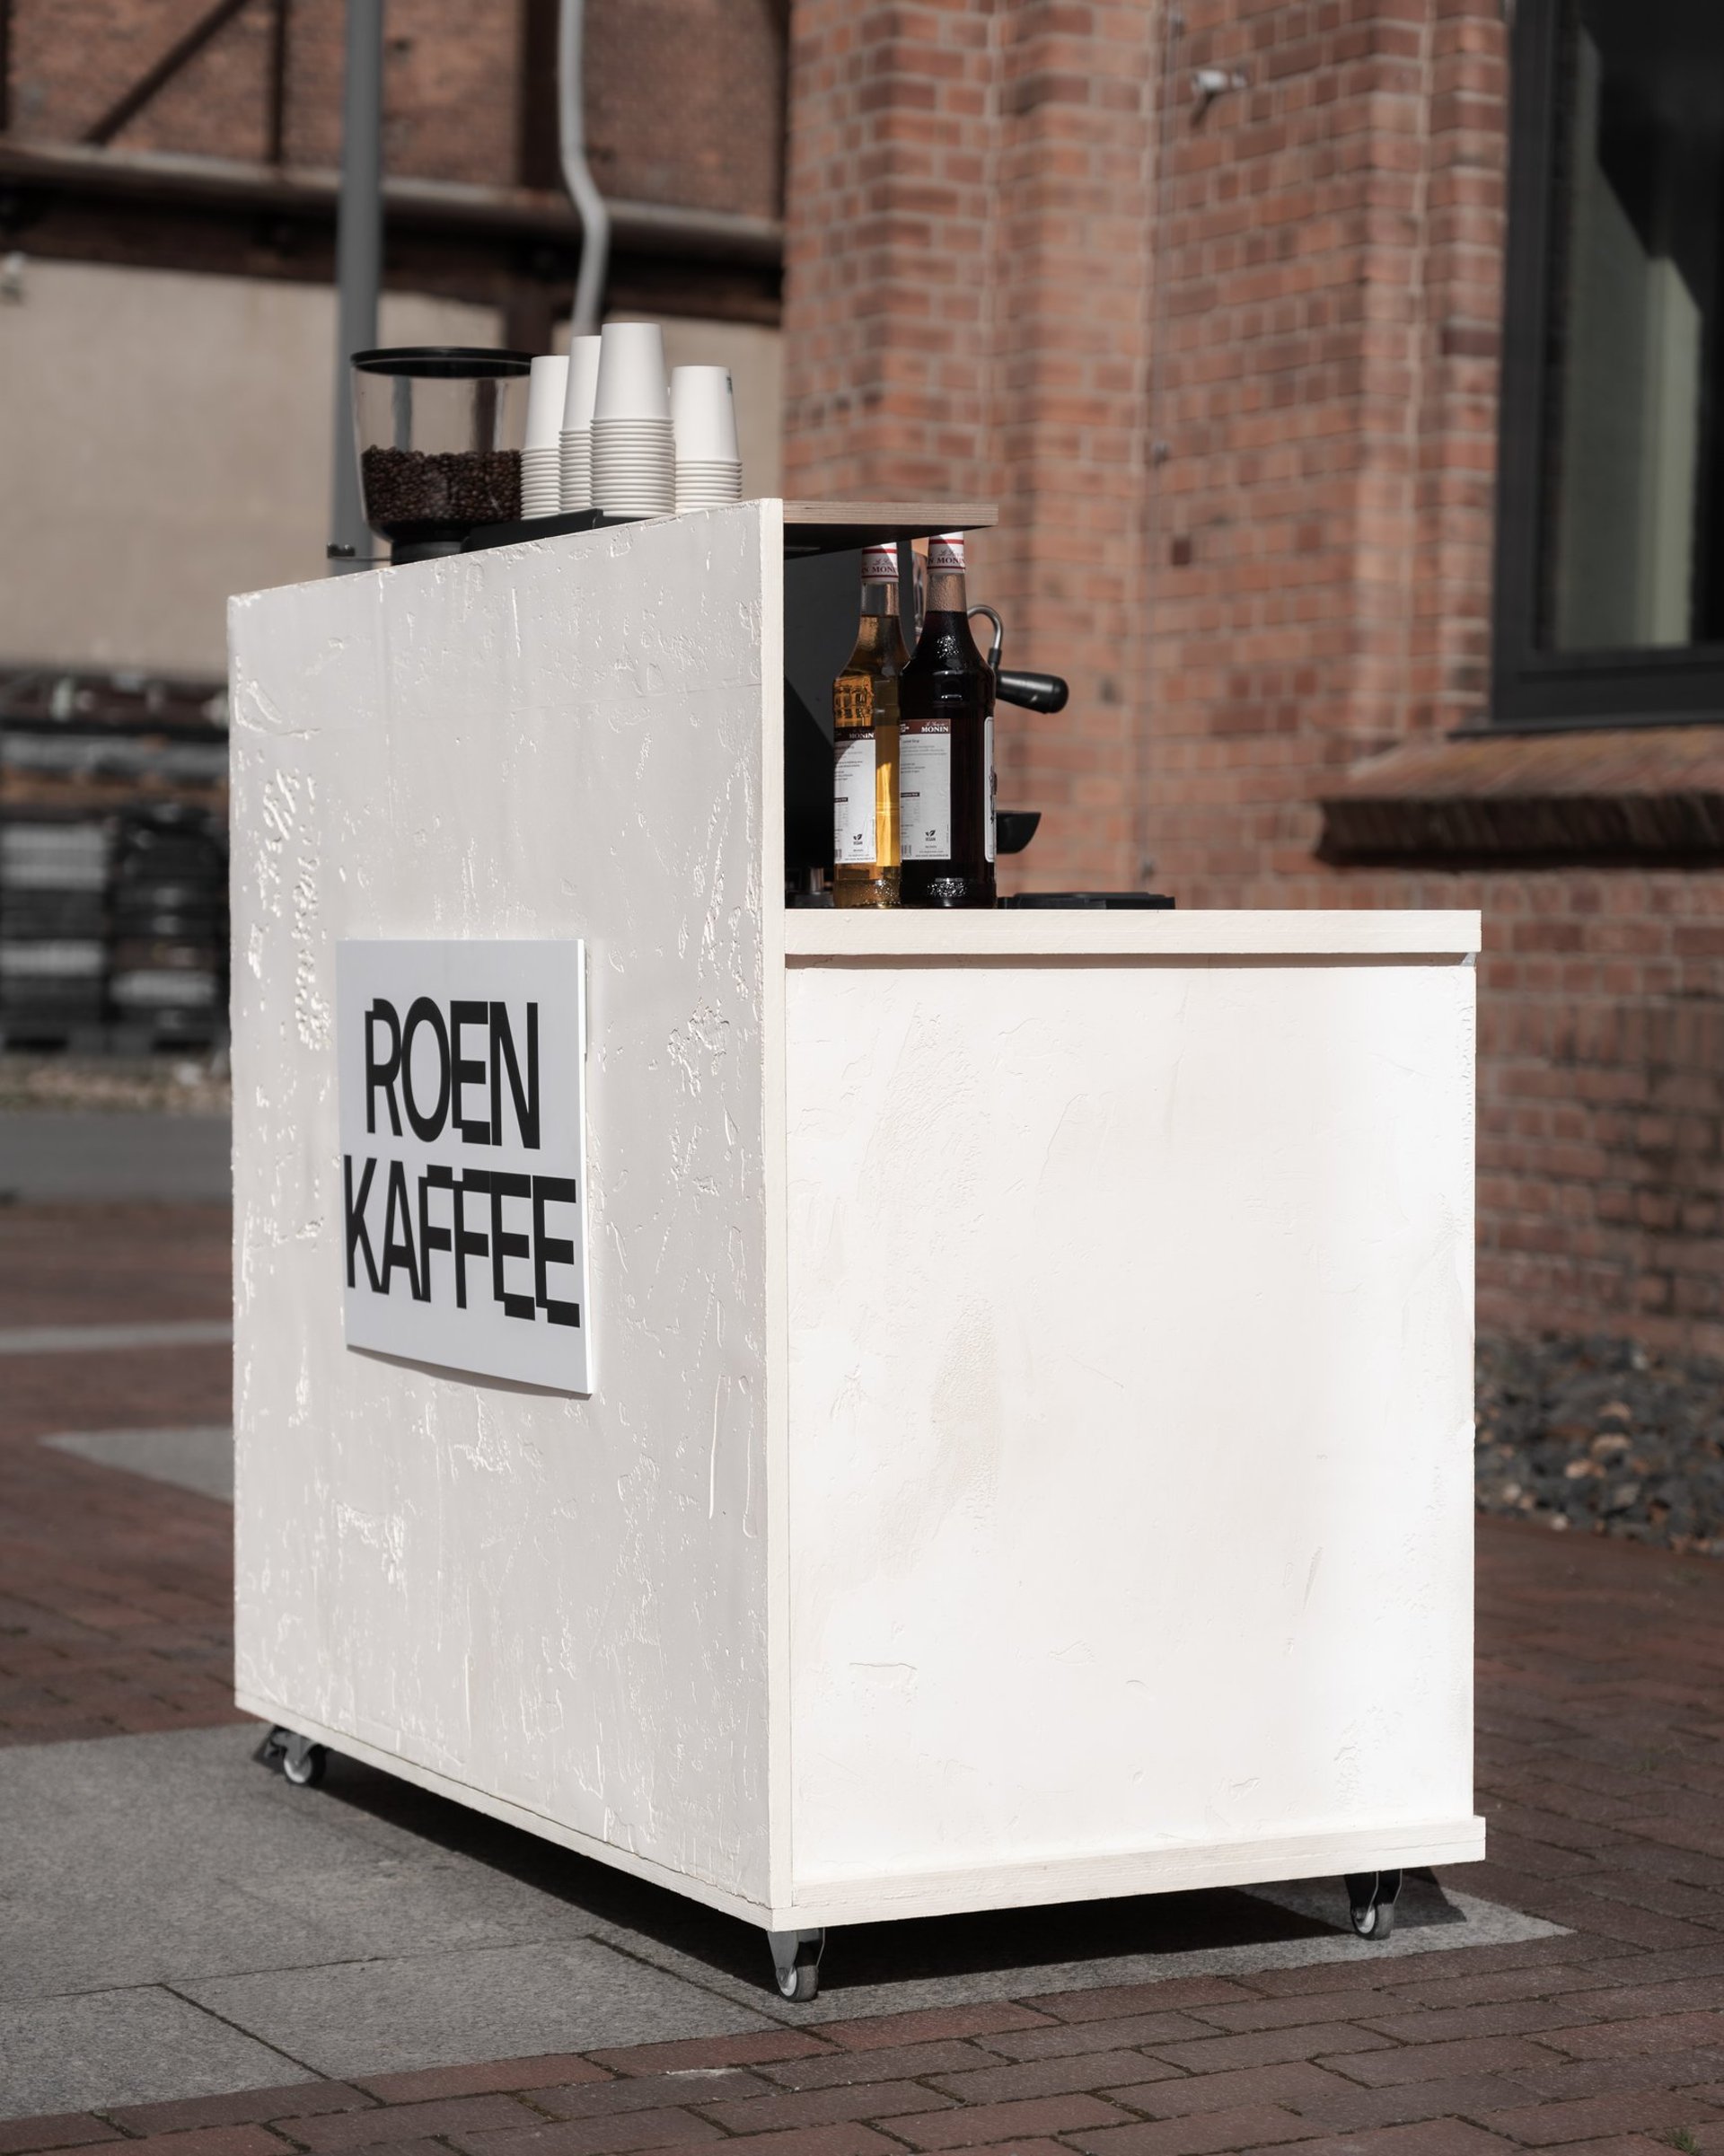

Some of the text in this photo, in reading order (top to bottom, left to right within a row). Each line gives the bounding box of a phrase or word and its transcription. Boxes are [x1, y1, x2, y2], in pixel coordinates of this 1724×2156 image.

[872, 566, 896, 574] MONI
[365, 996, 541, 1149] ROEN
[344, 1154, 581, 1328] KAFFEE
